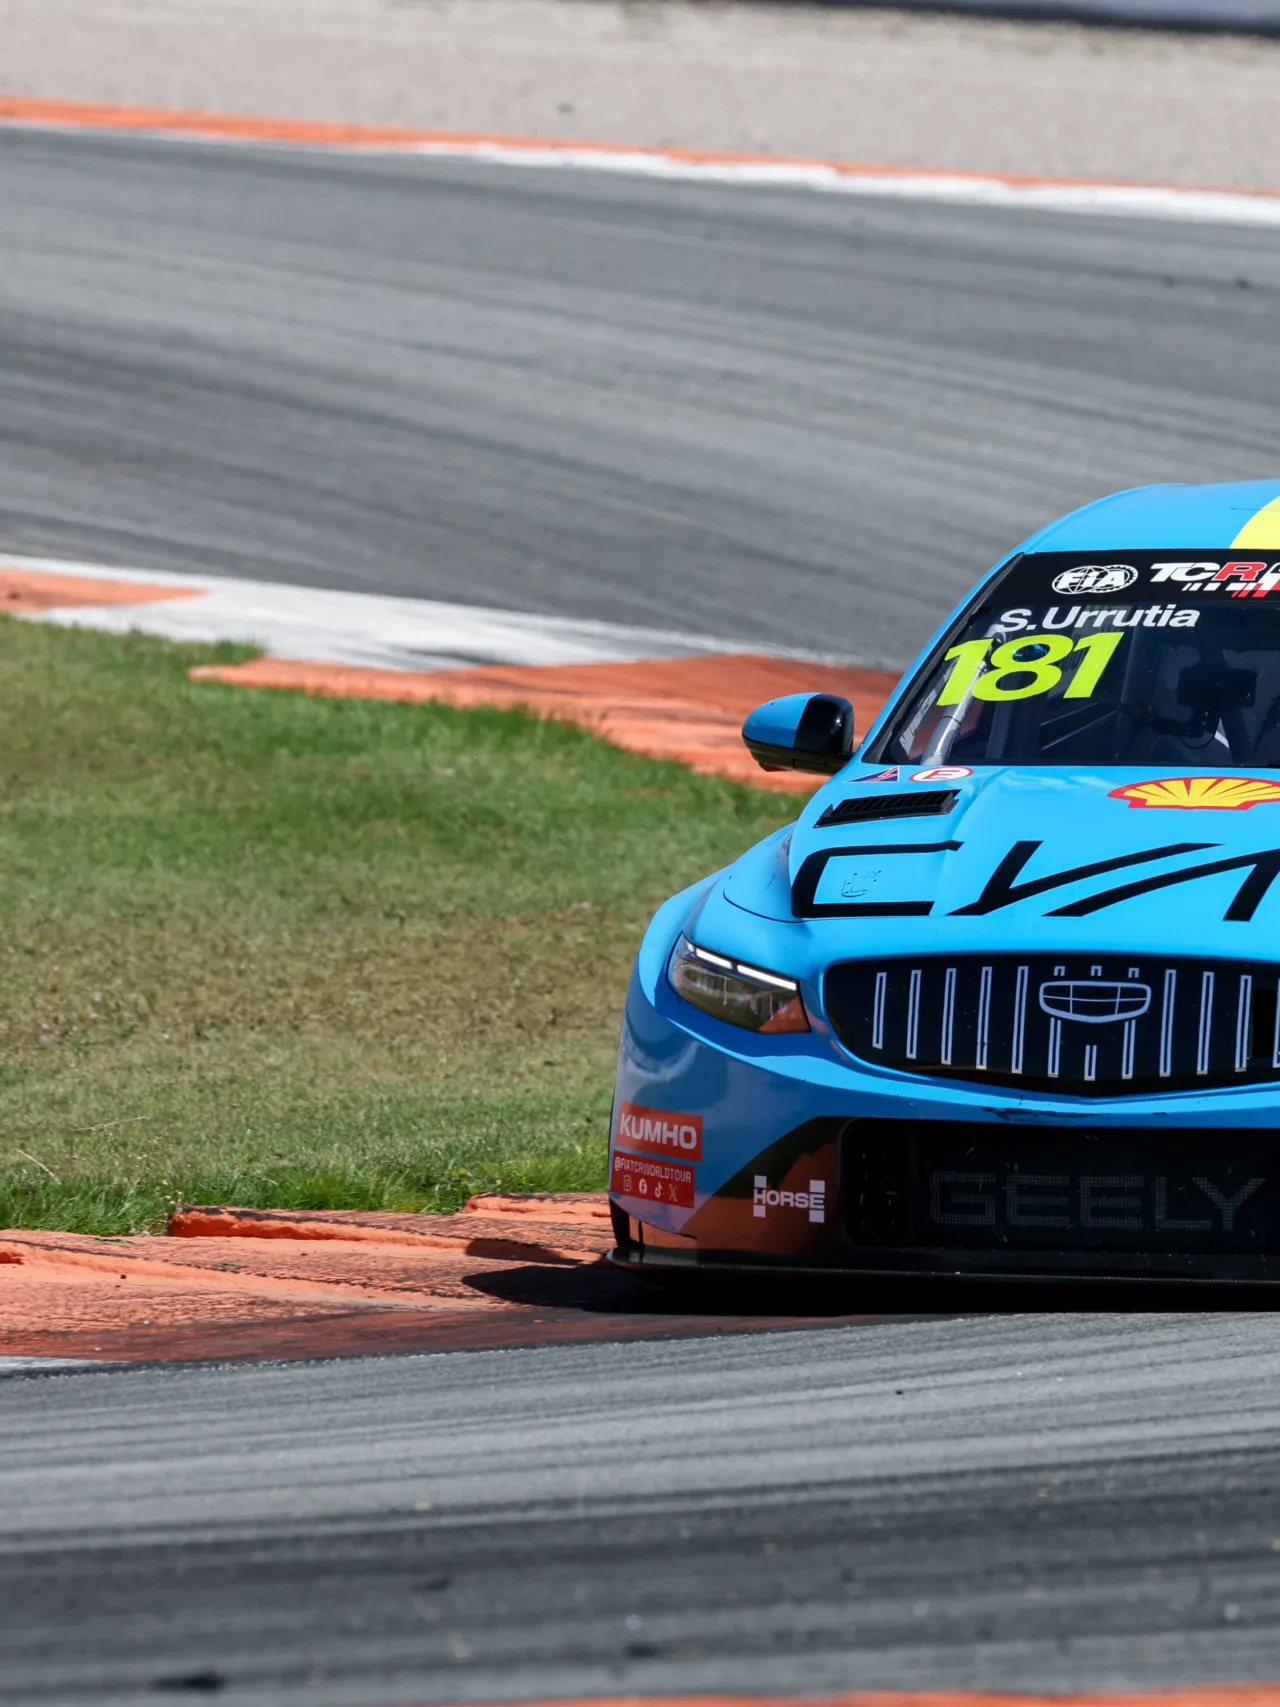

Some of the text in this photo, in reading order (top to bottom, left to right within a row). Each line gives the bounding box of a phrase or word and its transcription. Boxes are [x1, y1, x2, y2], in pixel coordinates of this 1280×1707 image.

[1150, 561, 1268, 583] TCR
[998, 604, 1200, 632] S.Urrutia
[936, 632, 1125, 706] 181
[619, 1112, 697, 1150] KUMHO
[930, 1170, 1267, 1231] GEELY
